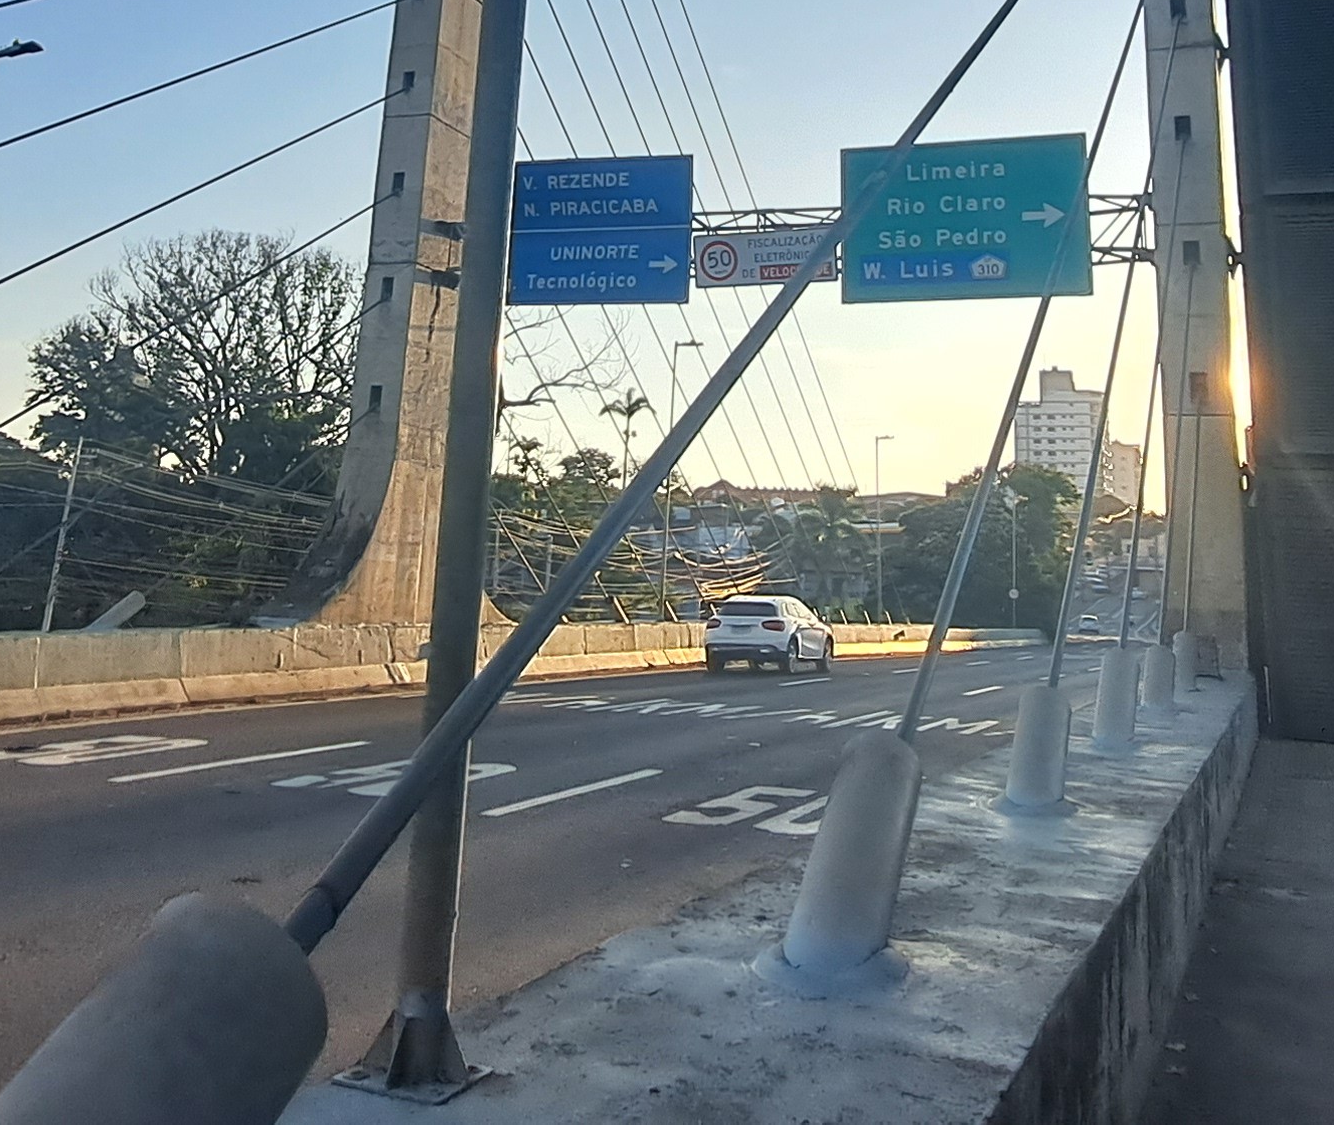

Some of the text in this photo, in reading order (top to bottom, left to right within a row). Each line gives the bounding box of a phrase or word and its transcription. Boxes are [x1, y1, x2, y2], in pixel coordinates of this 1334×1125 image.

[906, 160, 1006, 181] Limeira
[523, 172, 630, 190] V. REZENDE
[524, 198, 659, 217] N. PIRACICABA
[887, 195, 1007, 215] Rio Claro
[878, 227, 1007, 249] São Pedro
[550, 244, 640, 261] UNINORTE
[707, 249, 732, 269] 50
[754, 249, 811, 263] ELETRÔNIC
[742, 268, 756, 279] DE
[863, 259, 954, 280] W. Luis
[977, 263, 999, 275] 310
[528, 271, 637, 292] Tecnológico
